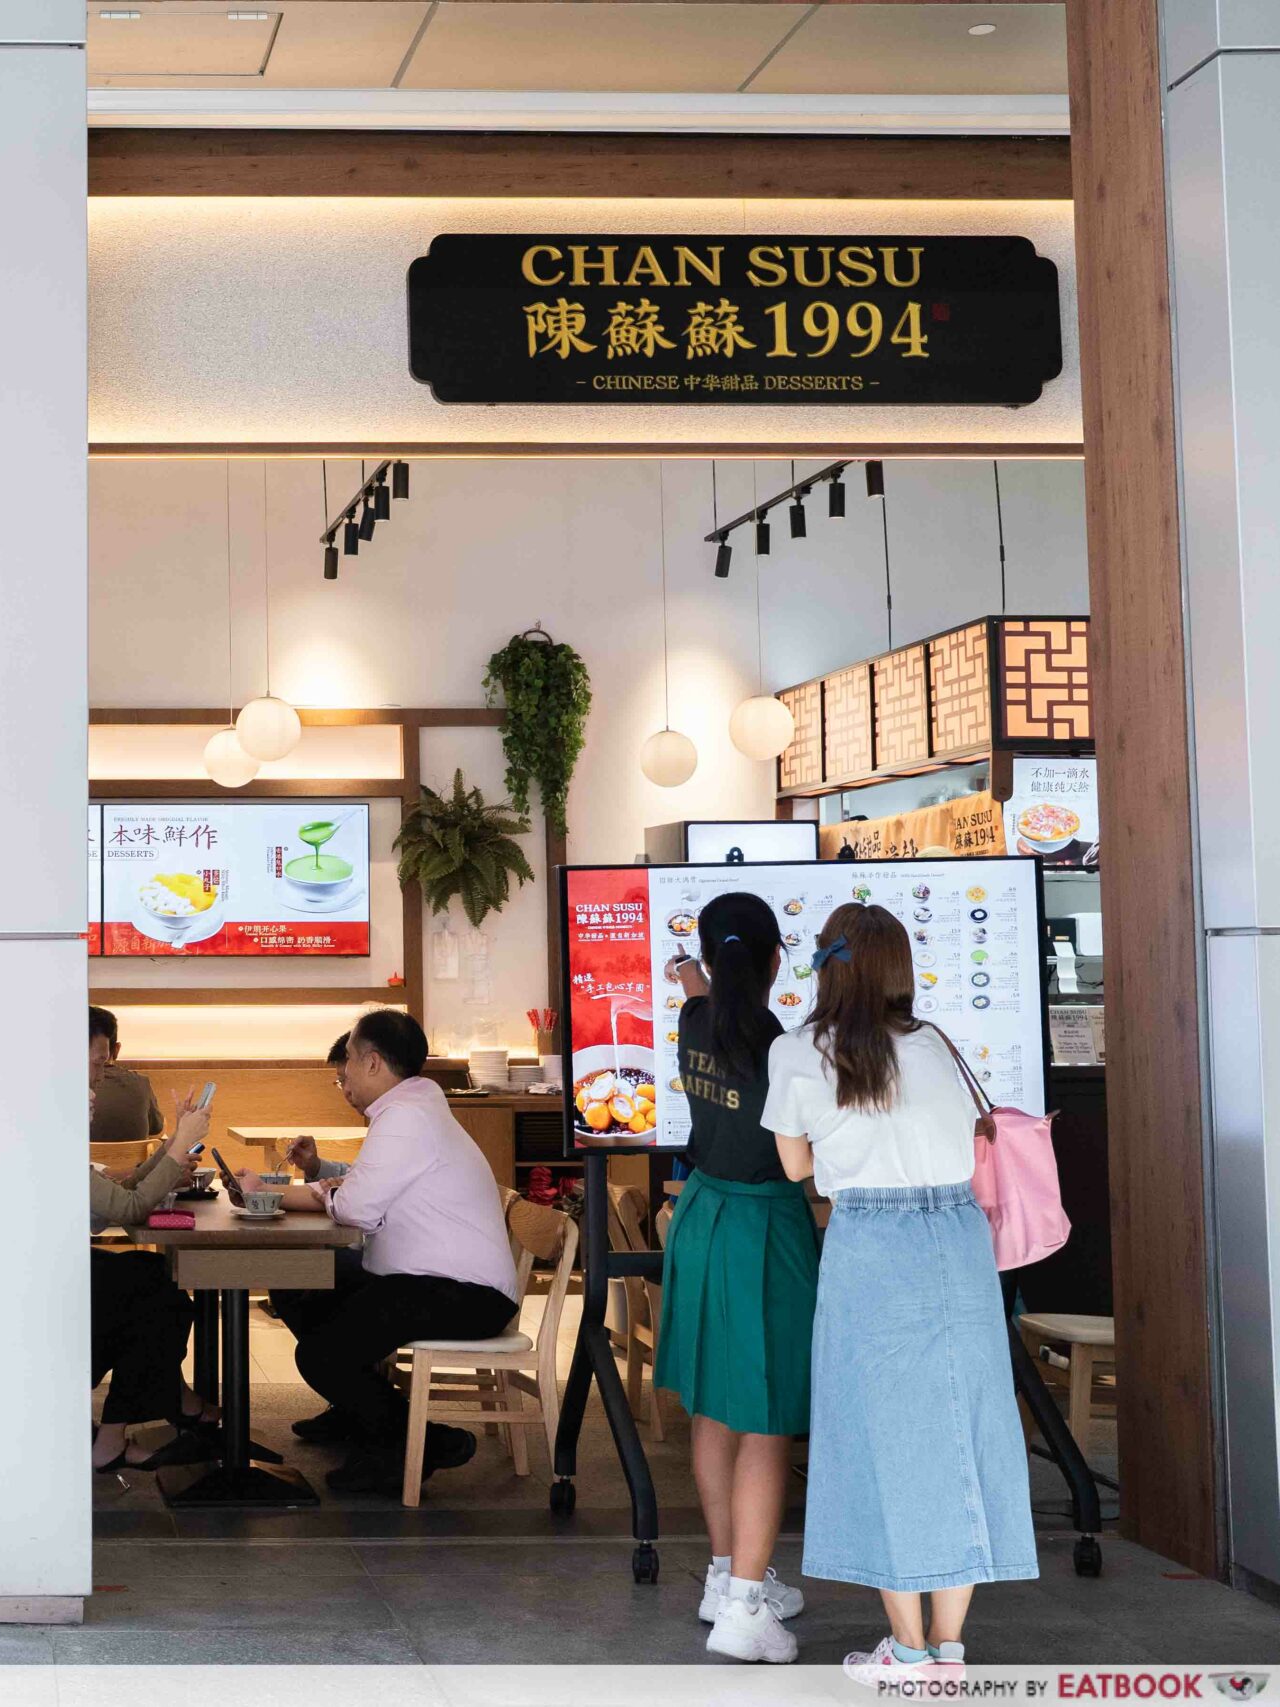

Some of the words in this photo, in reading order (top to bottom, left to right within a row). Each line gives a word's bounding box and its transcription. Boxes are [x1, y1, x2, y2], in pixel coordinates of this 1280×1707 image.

[521, 245, 724, 286] CHAN
[746, 246, 924, 288] SUSU
[522, 297, 930, 360] 陳蘇蘇1994
[593, 375, 680, 391] CHINESE
[683, 373, 758, 392] 中华甜品
[764, 375, 863, 391] DESSERTS
[1031, 767, 1089, 778] 不加一滴水
[1031, 780, 1089, 792] 健康纯天然
[108, 824, 218, 850] 本味鮮作
[107, 850, 154, 858] DESSERTS
[576, 904, 610, 912] CHAN
[613, 903, 643, 911] SUSU
[687, 1048, 726, 1079] TEA
[680, 1073, 740, 1110] AFFLES
